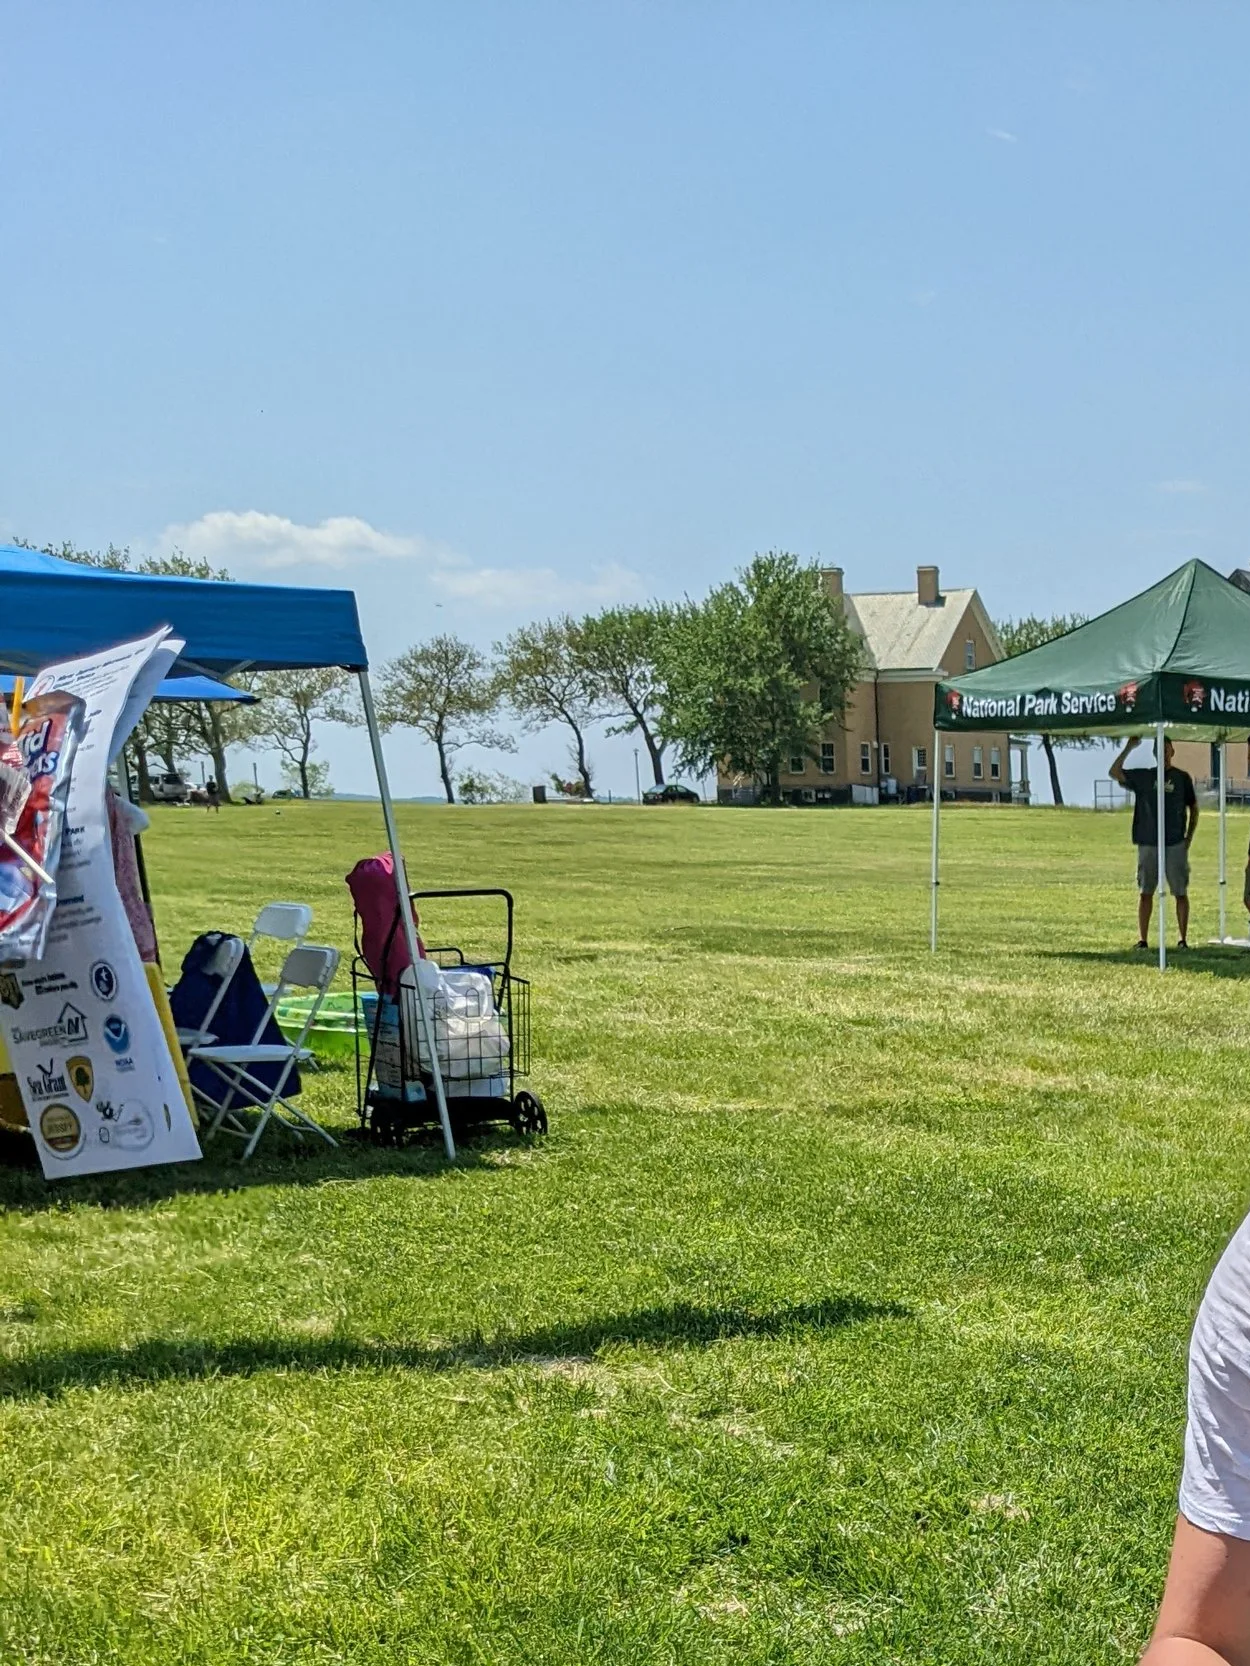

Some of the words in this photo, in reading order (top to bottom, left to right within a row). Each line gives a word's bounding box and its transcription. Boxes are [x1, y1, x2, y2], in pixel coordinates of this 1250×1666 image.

[962, 694, 1020, 718] National
[1024, 692, 1057, 716] Park
[1061, 691, 1116, 714] Service
